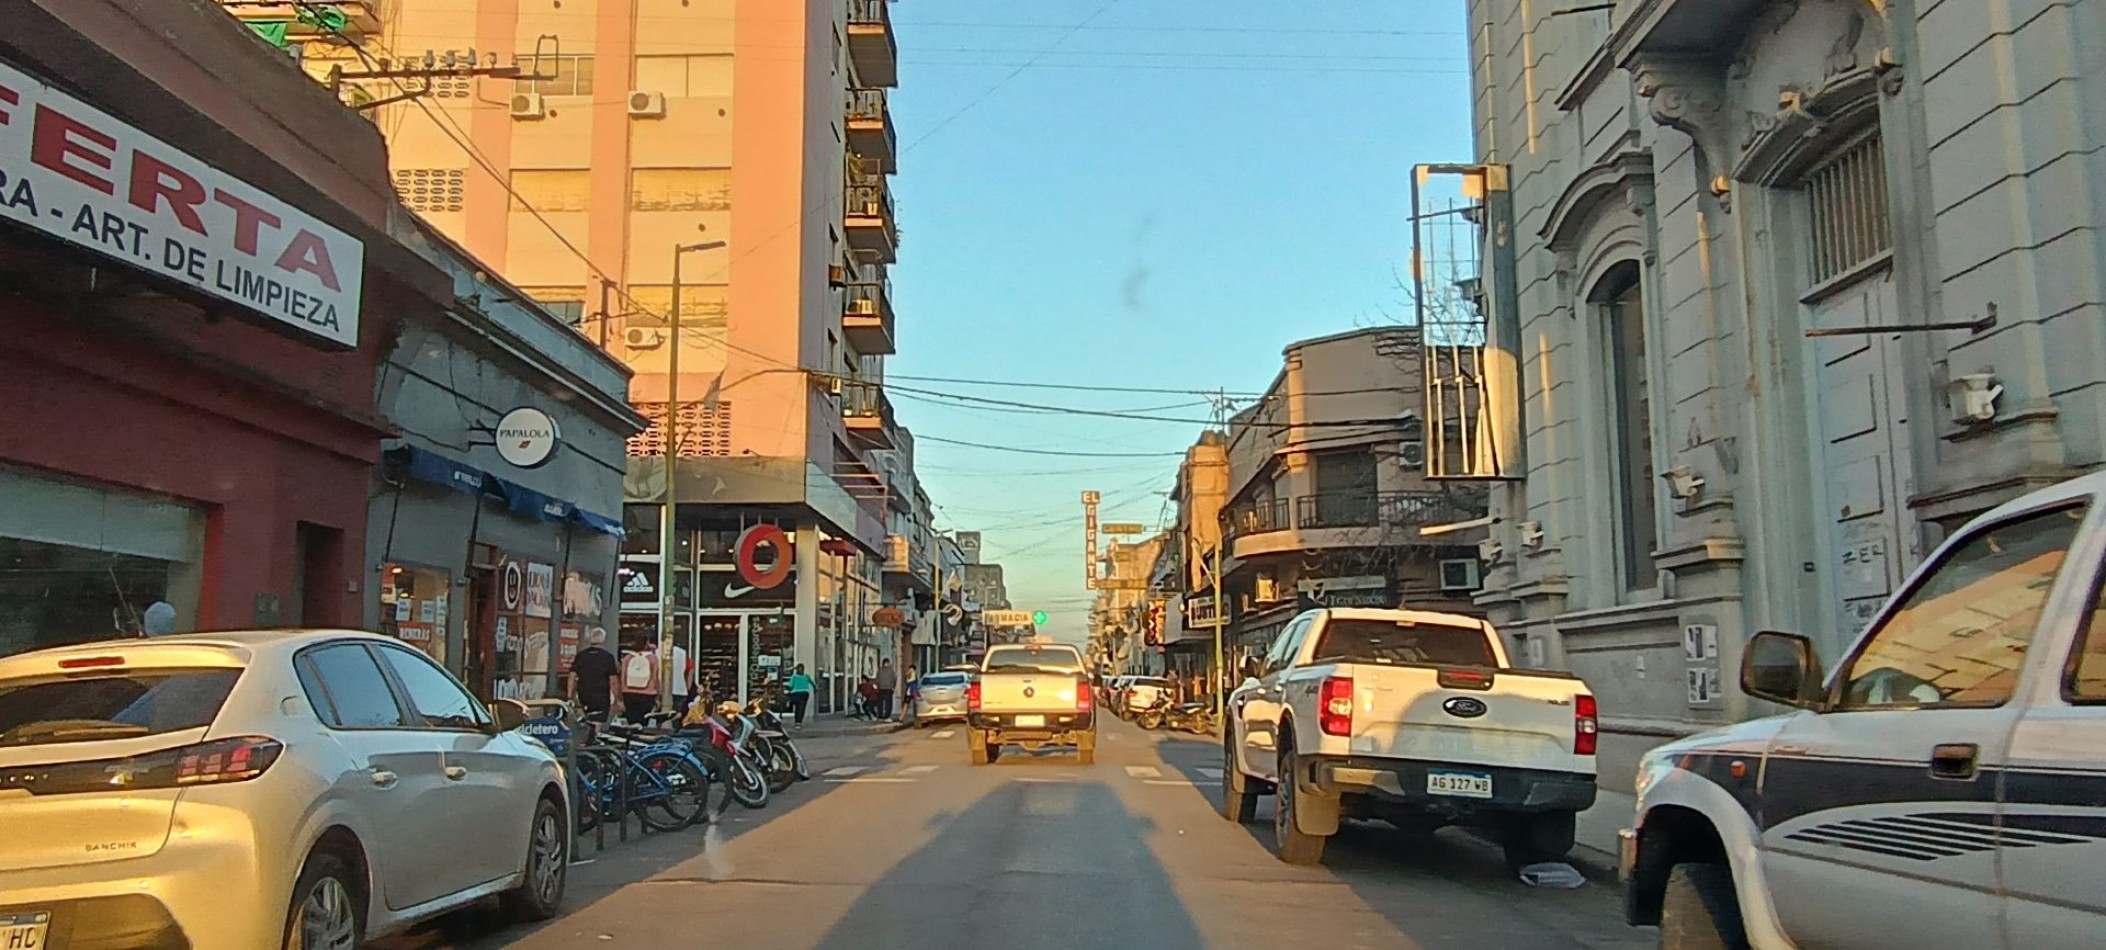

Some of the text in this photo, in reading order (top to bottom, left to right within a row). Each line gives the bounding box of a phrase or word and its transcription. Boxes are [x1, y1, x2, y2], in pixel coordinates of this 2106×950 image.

[0, 84, 342, 294] ERTA
[72, 203, 151, 261] ART.
[164, 237, 207, 282] DE
[216, 259, 340, 333] LIMPIEZA
[499, 429, 550, 438] PAPALOLA
[1082, 492, 1099, 502] EL
[1087, 504, 1096, 589] GIGANTE
[985, 613, 1029, 622] FARMACIA
[1431, 778, 1489, 792] AG 127 WB
[9, 926, 37, 949] HC
